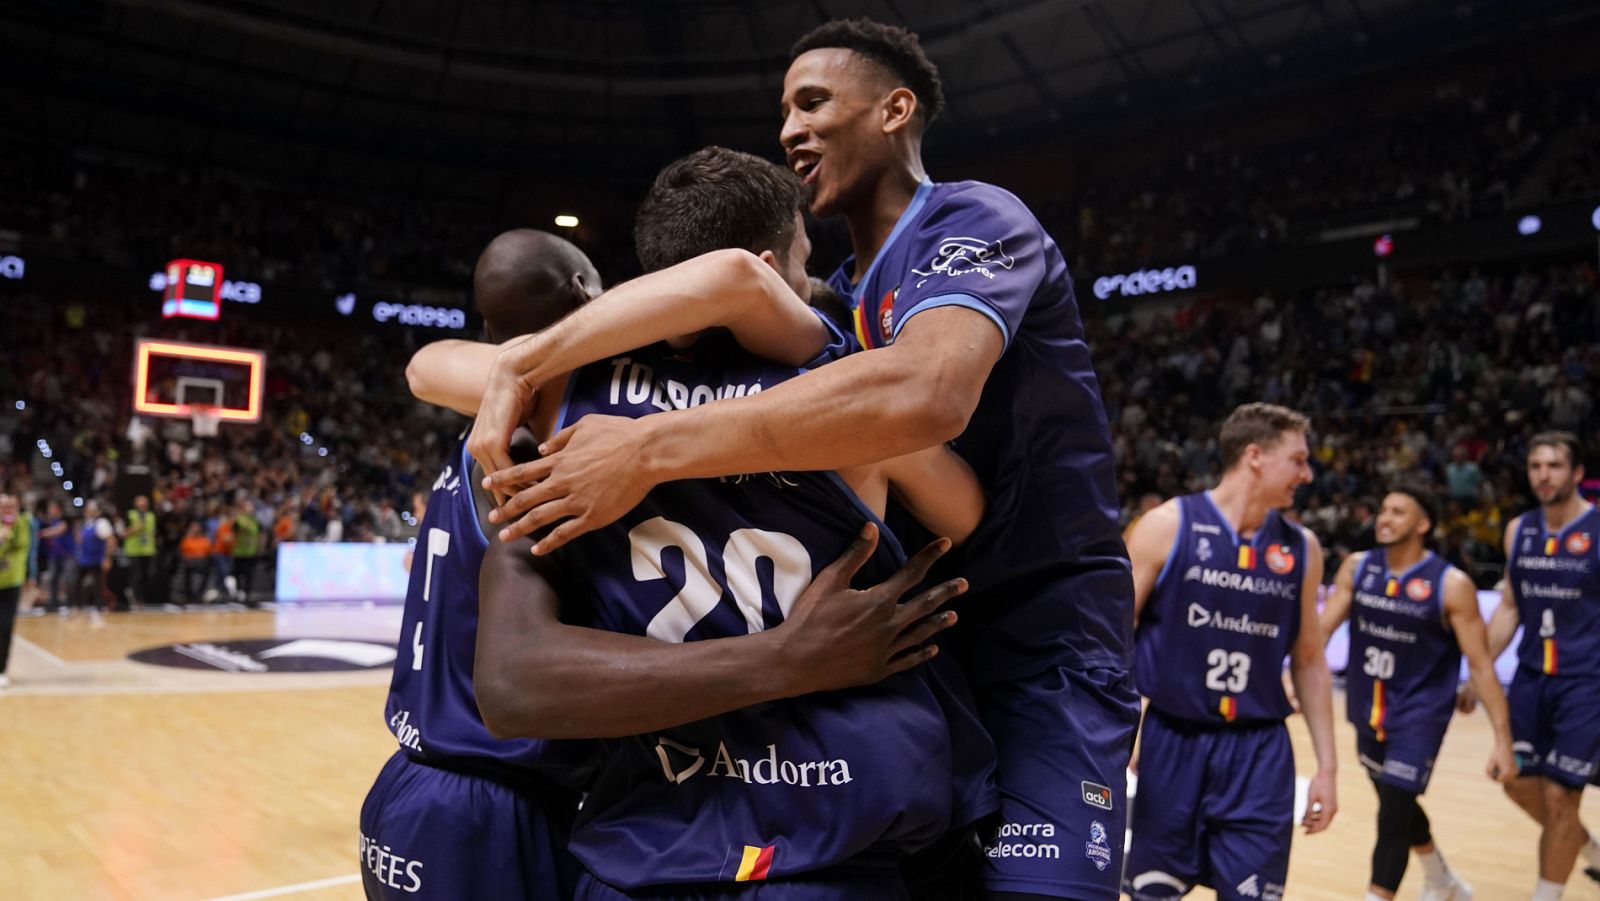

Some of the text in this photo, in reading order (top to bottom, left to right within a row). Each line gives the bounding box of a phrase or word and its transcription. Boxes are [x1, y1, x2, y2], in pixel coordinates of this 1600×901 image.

[1093, 264, 1197, 300] endesa
[372, 302, 466, 329] endesa
[628, 515, 812, 643] 20
[1202, 568, 1296, 600] MORABANC
[1208, 609, 1280, 639] Andorra
[1206, 648, 1251, 694] 23
[1363, 646, 1396, 680] 30
[707, 740, 854, 788] Andorra
[1085, 790, 1106, 806] acb
